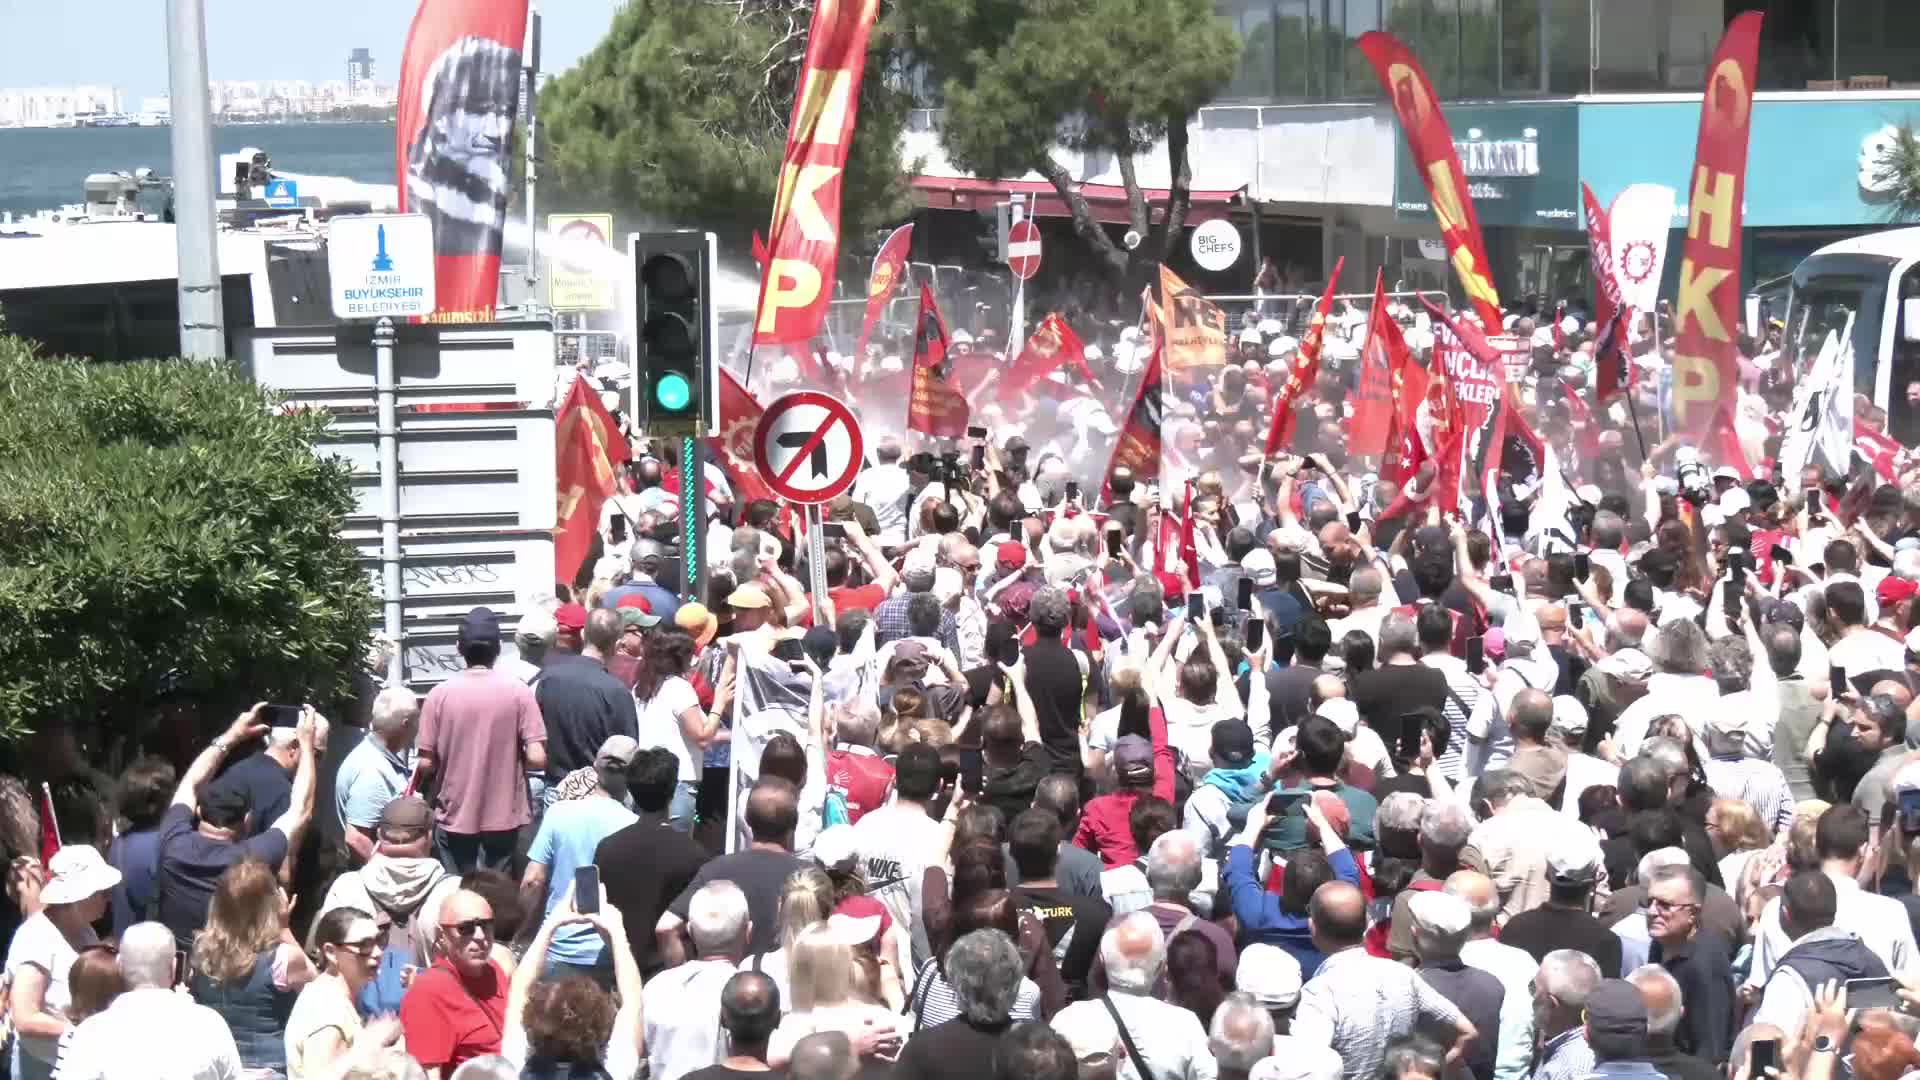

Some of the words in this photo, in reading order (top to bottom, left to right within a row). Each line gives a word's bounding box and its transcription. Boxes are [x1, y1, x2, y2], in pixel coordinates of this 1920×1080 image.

[1199, 235, 1216, 244] BIG
[1199, 243, 1233, 253] CHEFS
[867, 857, 901, 880] NIKE
